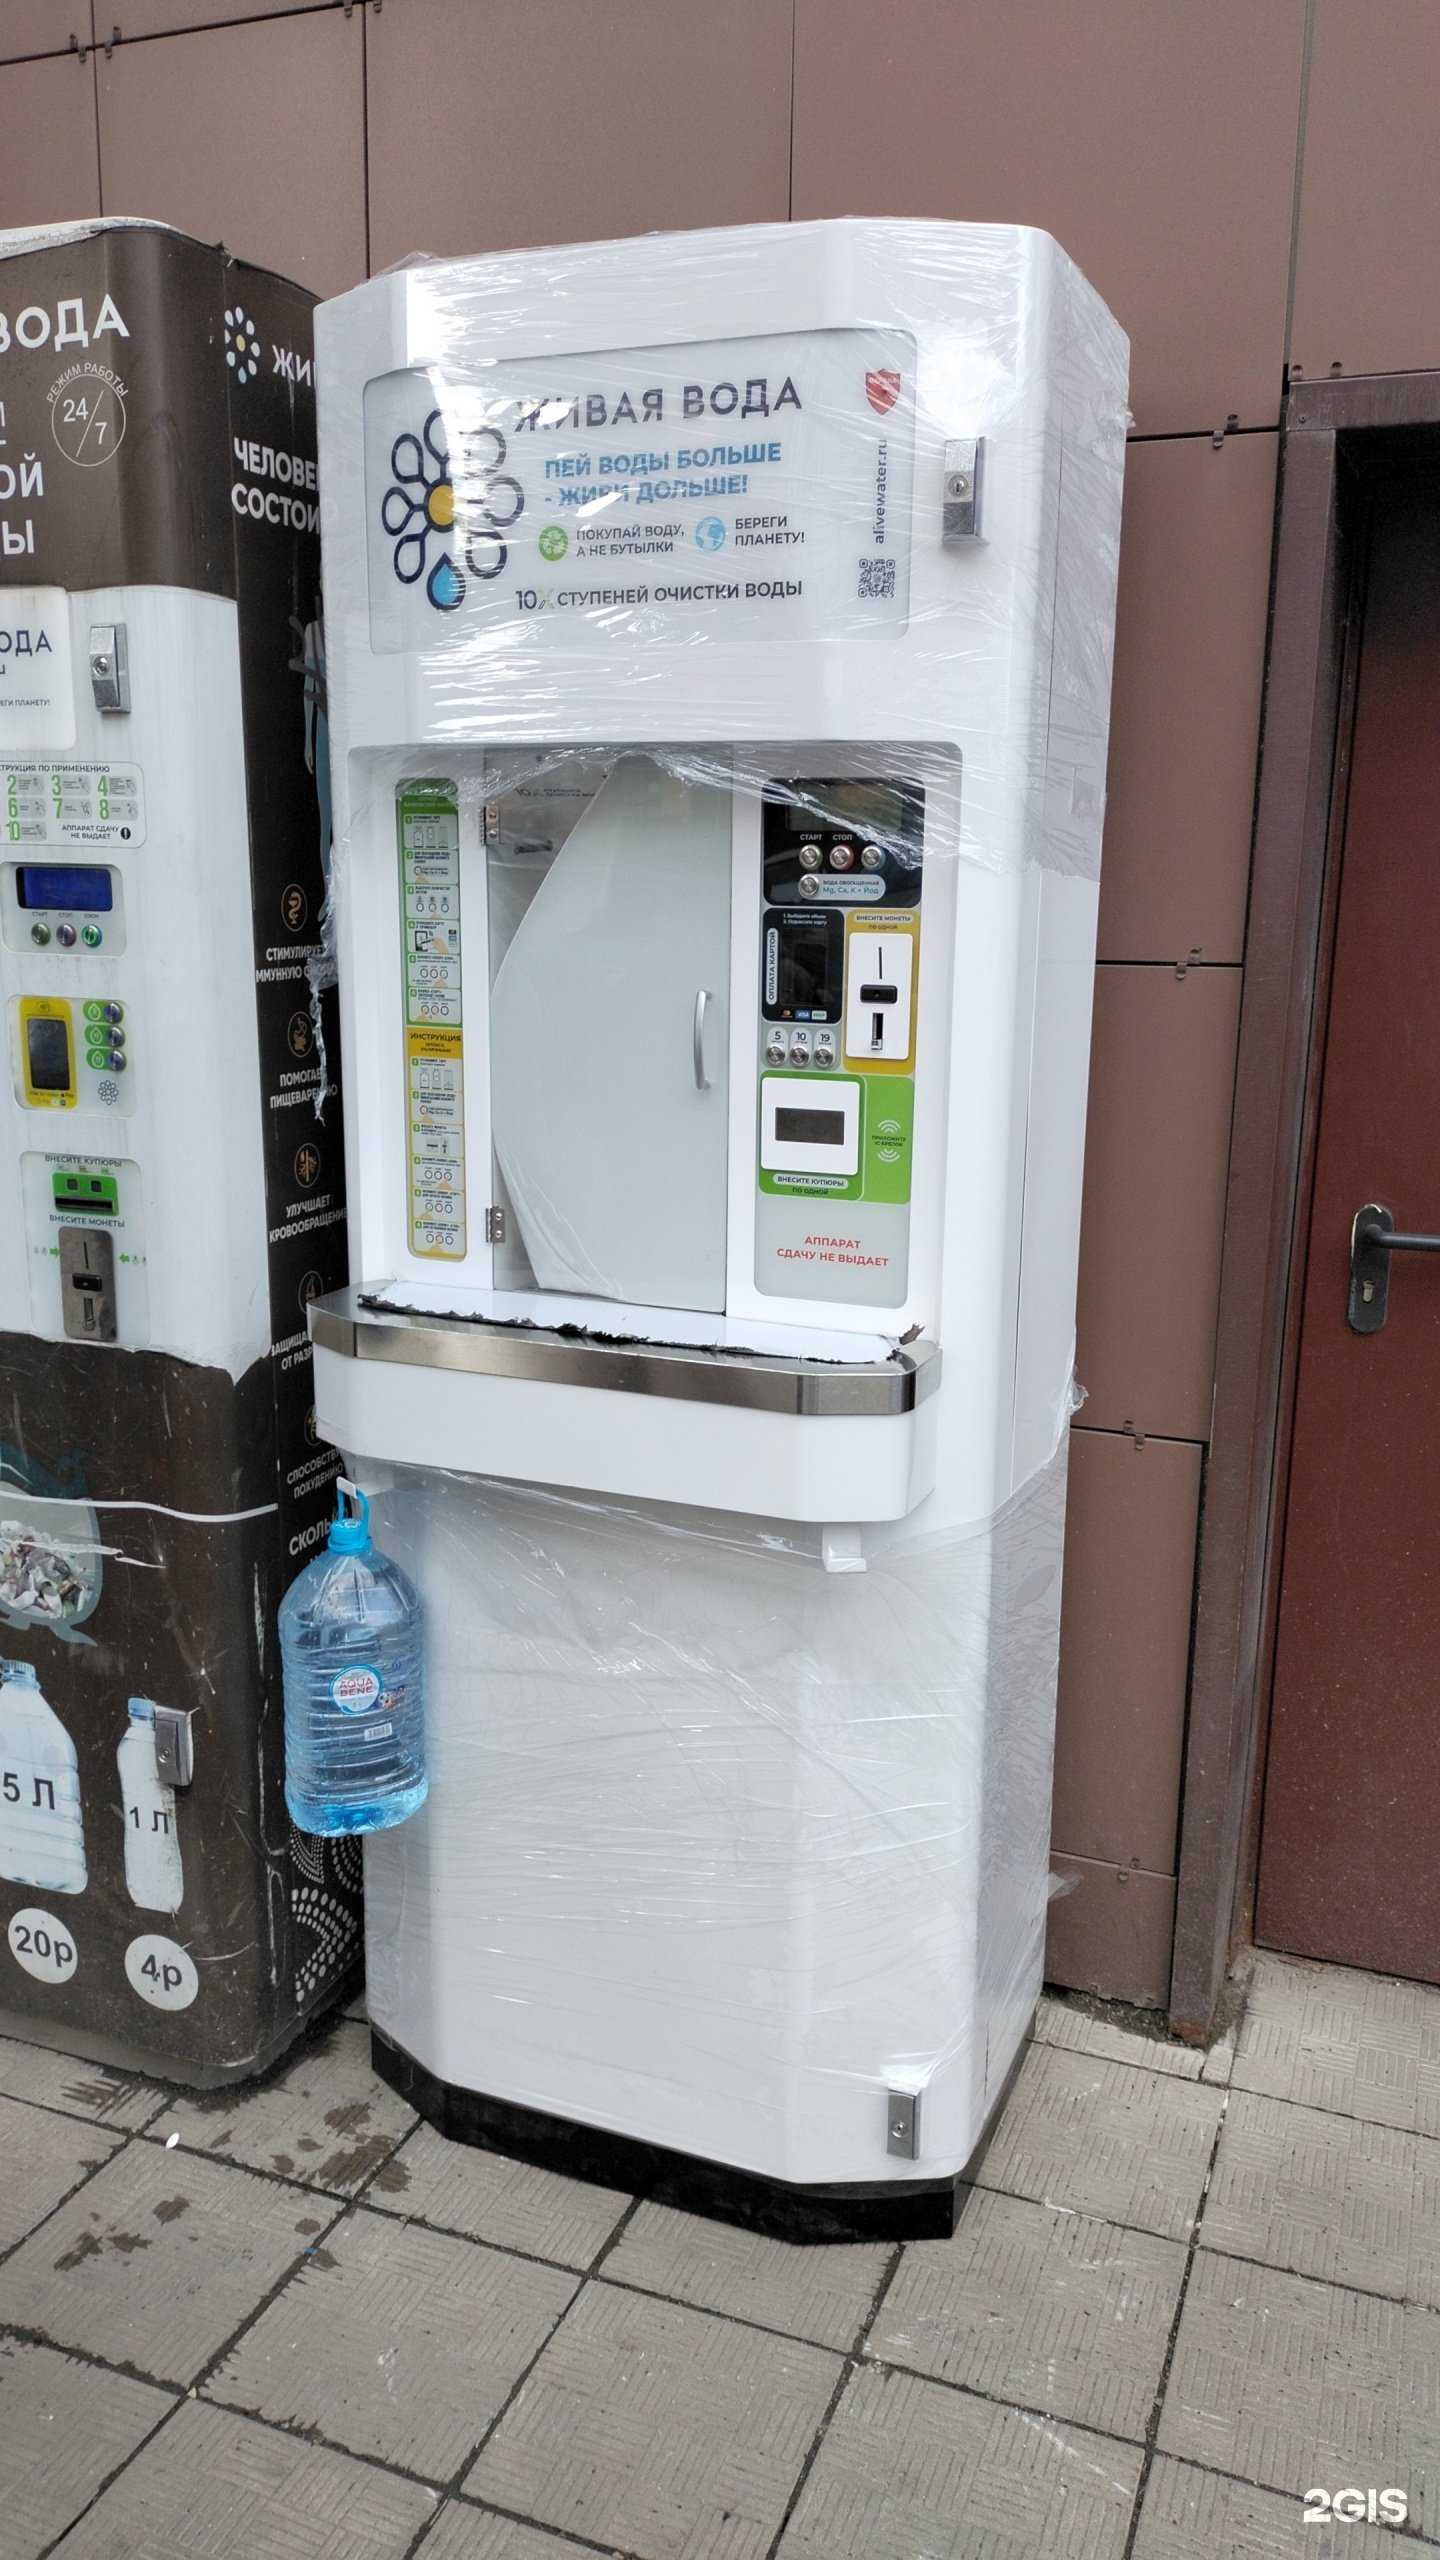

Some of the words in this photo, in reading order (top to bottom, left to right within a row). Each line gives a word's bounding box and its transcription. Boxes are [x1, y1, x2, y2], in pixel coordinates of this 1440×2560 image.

[272, 344, 317, 388] ЖИ
[46, 363, 81, 403] РЕЖИМ
[84, 362, 129, 397] РАБОТЫ
[683, 376, 802, 419] ВОДА
[234, 437, 320, 491] ЧЕЛОВЕ
[545, 452, 591, 479] ПЕЙ
[599, 450, 669, 476] ВОДЫ
[677, 442, 782, 470] БОЛЬШЕ
[636, 474, 748, 503] ДОЛЬШЕ!
[873, 439, 888, 545] alivewater.ru
[576, 524, 641, 541] ПОКУПАЙ
[645, 524, 685, 537] ВОДУ,
[735, 516, 788, 530] БЕРЕГИ
[576, 547, 586, 557] А
[590, 545, 606, 556] НЕ
[610, 541, 674, 556] БУТЫЛКИ
[735, 532, 805, 547] ПЛАНЕТУ!
[557, 584, 649, 607] СТУПЕНЕЙ
[654, 584, 740, 601] ОЧИСТКИ
[745, 580, 803, 599] ВОДЫ
[52, 765, 111, 774] ПРИМЕНЕНИЮ
[8, 774, 17, 796] 2
[52, 774, 62, 796] 3
[97, 774, 109, 797] 4
[8, 797, 18, 818] 6
[53, 798, 64, 819] 7
[99, 798, 110, 821] 8
[61, 824, 95, 833] АППАРАТ
[96, 825, 119, 833] СДАЧУ
[70, 832, 81, 840] НЕ
[800, 833, 823, 842] СТАРТ
[832, 833, 853, 842] СТОП
[265, 944, 327, 962] СТИМУЛИРУЕ
[769, 930, 778, 965] КАРТОЙ
[774, 1031, 782, 1040] 5
[796, 1032, 807, 1041] 10
[280, 1067, 325, 1087] ПОМОГАЕ
[270, 1083, 338, 1109] ПИЩЕВАРЕЮ
[777, 1175, 811, 1185] ВНЕСИТЕ
[811, 1177, 845, 1187] КУПЮРЫ
[286, 1193, 331, 1219] УЛУЧШАЕТ
[49, 1213, 87, 1225] ВНЕСИТЕ
[804, 1234, 862, 1250] АППАРАТ
[776, 1247, 817, 1261] СДАЧУ
[819, 1251, 836, 1262] НЕ
[838, 1253, 889, 1267] ВЫДАЕТ
[281, 1354, 293, 1370] ОТ
[288, 1510, 336, 1556] СКОЛЬ
[339, 1676, 374, 1689] AQUA
[339, 1686, 375, 1697] BENE
[3, 1771, 21, 1802] 5
[32, 1777, 56, 1811] Л
[129, 1806, 140, 1829] 1
[151, 1810, 170, 1834] Л
[14, 1924, 73, 1968] 20р
